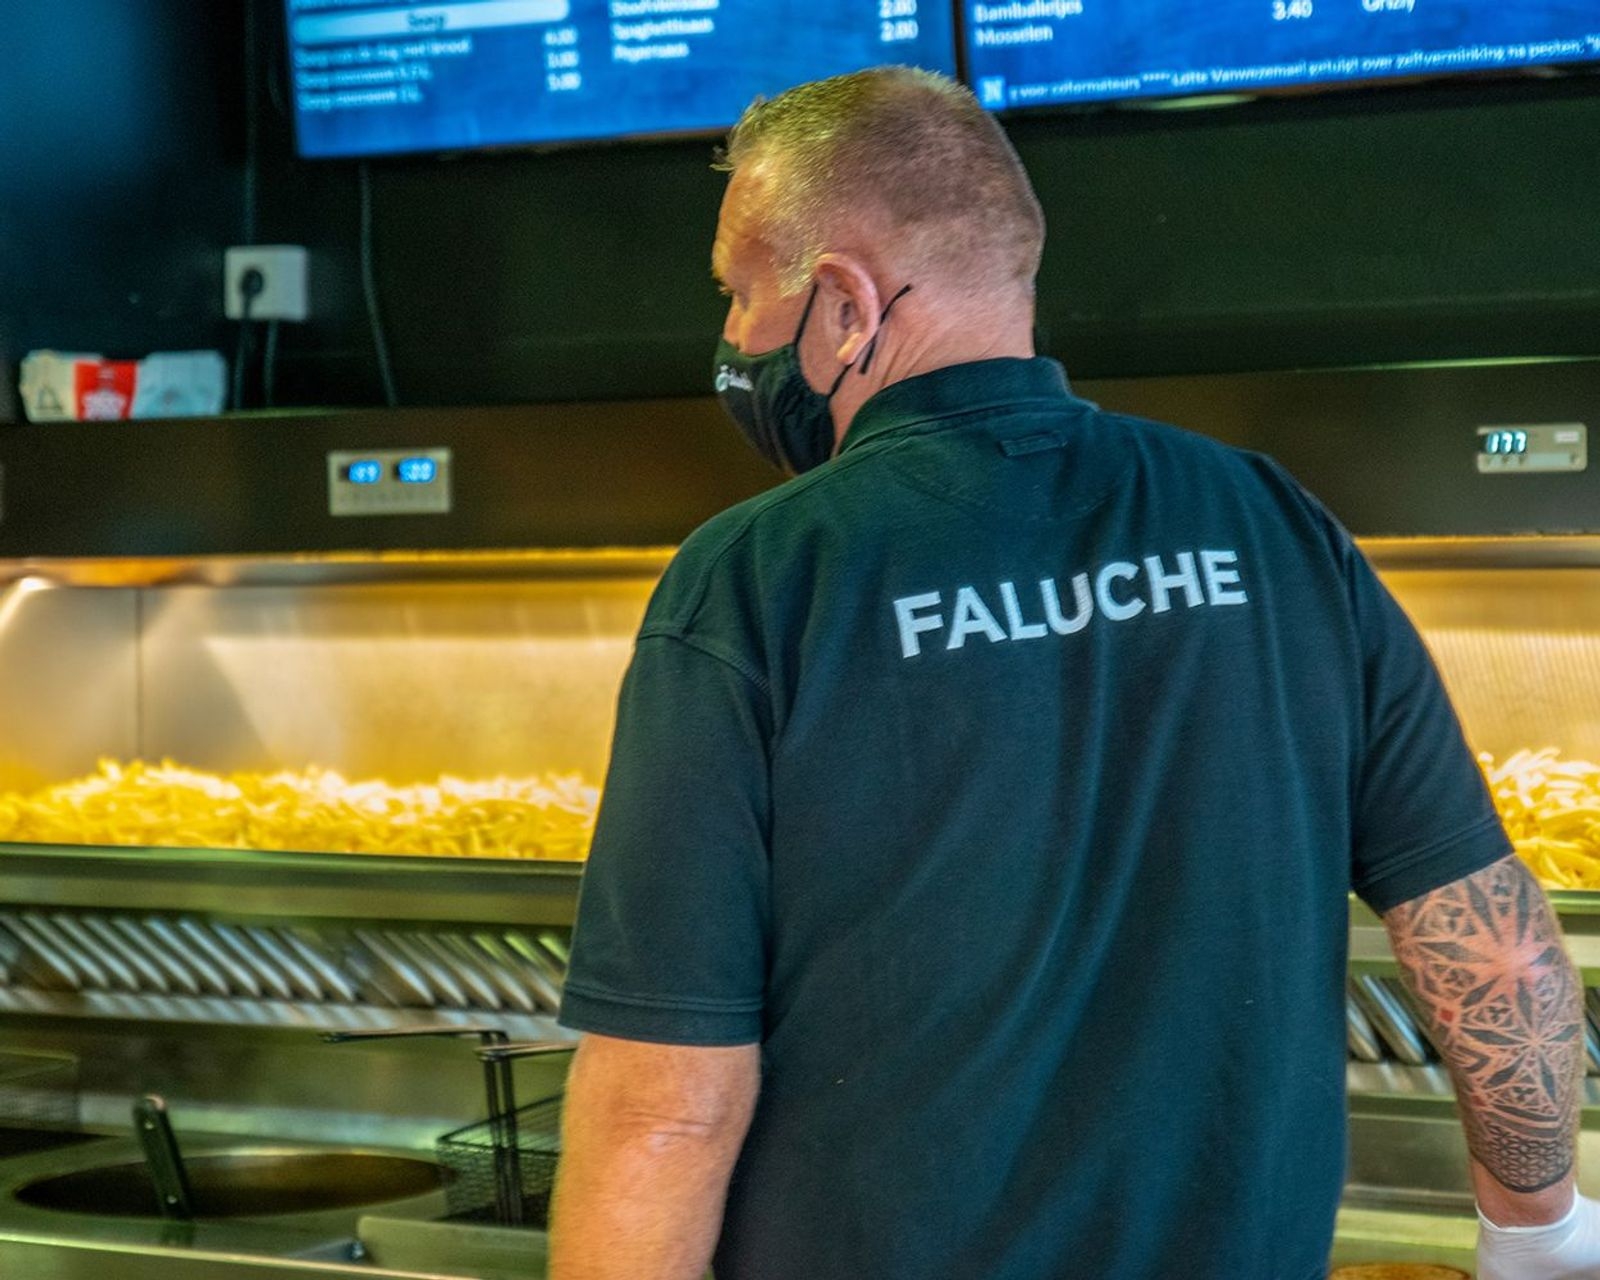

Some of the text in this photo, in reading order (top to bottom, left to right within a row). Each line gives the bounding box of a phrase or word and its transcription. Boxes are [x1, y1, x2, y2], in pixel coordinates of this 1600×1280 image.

[975, 25, 1054, 46] Mosselen
[1362, 56, 1393, 71] over
[1489, 431, 1527, 454] 177
[893, 550, 1249, 659] FALUCHE
